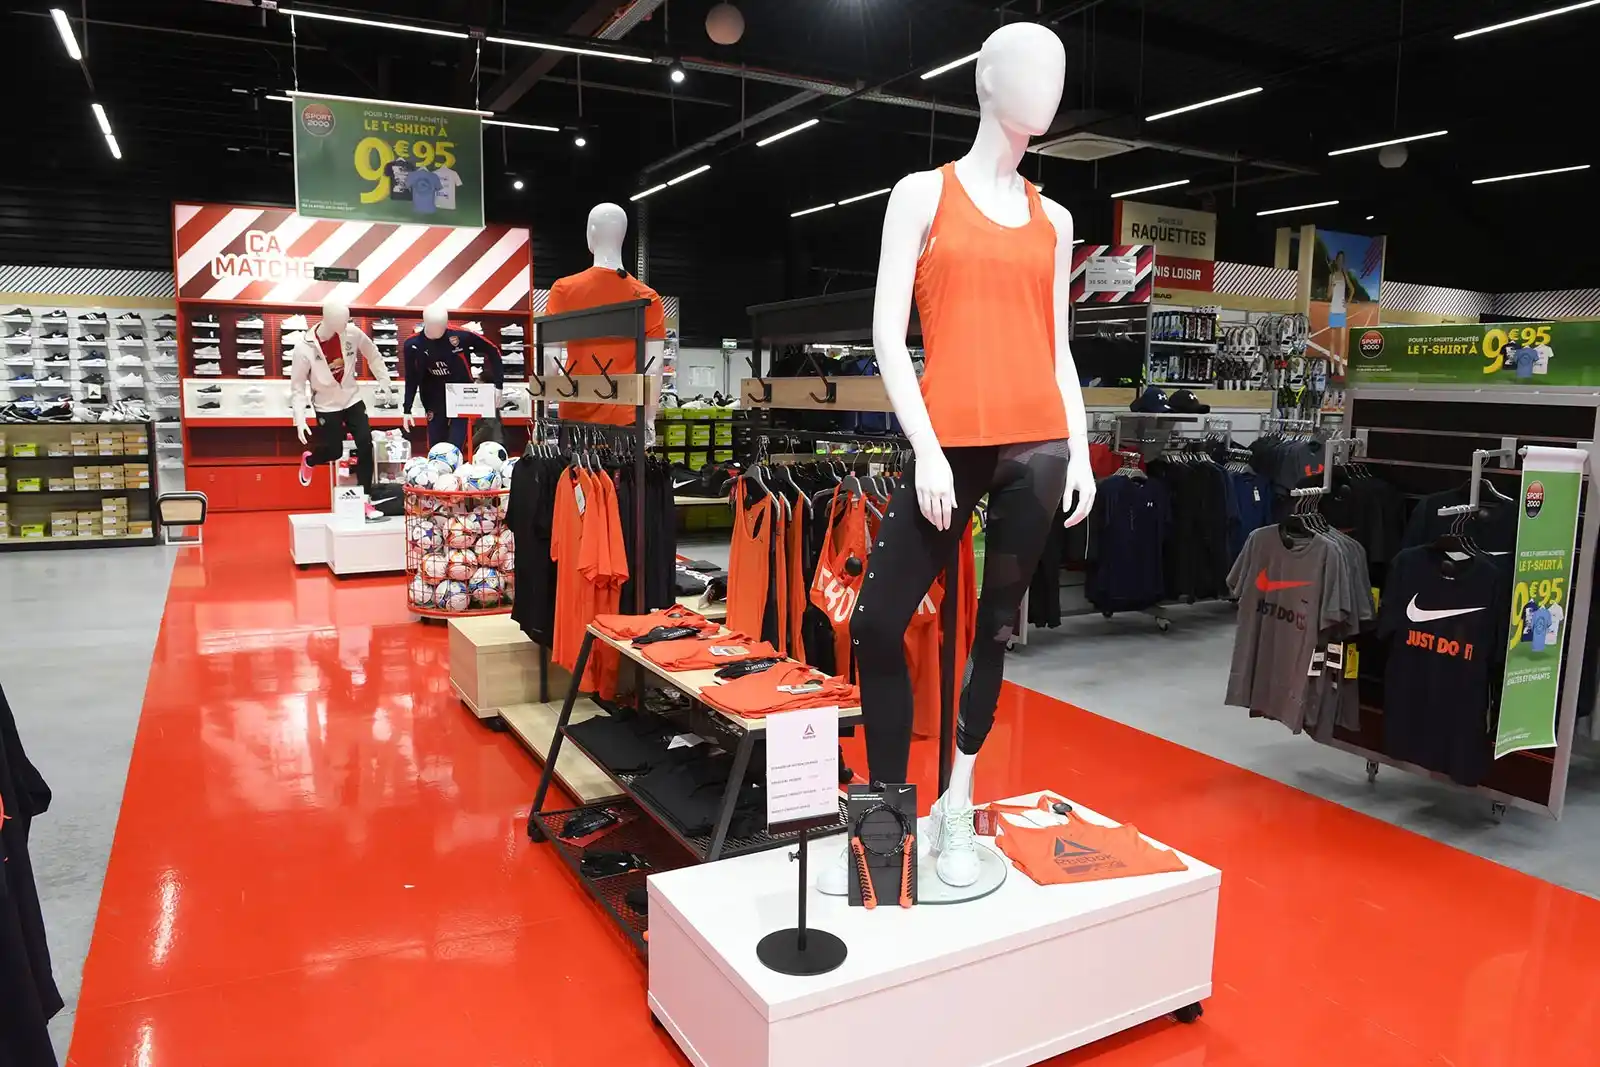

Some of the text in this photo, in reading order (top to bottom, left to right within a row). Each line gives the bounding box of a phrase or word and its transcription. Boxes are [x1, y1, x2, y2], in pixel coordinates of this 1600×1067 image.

[305, 112, 332, 121] SPORT
[308, 119, 330, 128] 2000
[364, 119, 379, 131] LE
[382, 120, 436, 136] T-SHIRT
[1132, 222, 1206, 246] RAQUETTES
[250, 234, 281, 257] ÇA
[1154, 264, 1202, 281] NIS LOISIR
[1408, 341, 1478, 355] LE T-SHIRT À
[1527, 492, 1543, 500] SPORT
[1518, 559, 1527, 572] LE
[1527, 558, 1558, 572] T-SHIRT
[1277, 606, 1295, 623] DO
[1406, 629, 1435, 651] JUST
[1436, 636, 1460, 657] DO
[1054, 854, 1112, 867] Reebok
